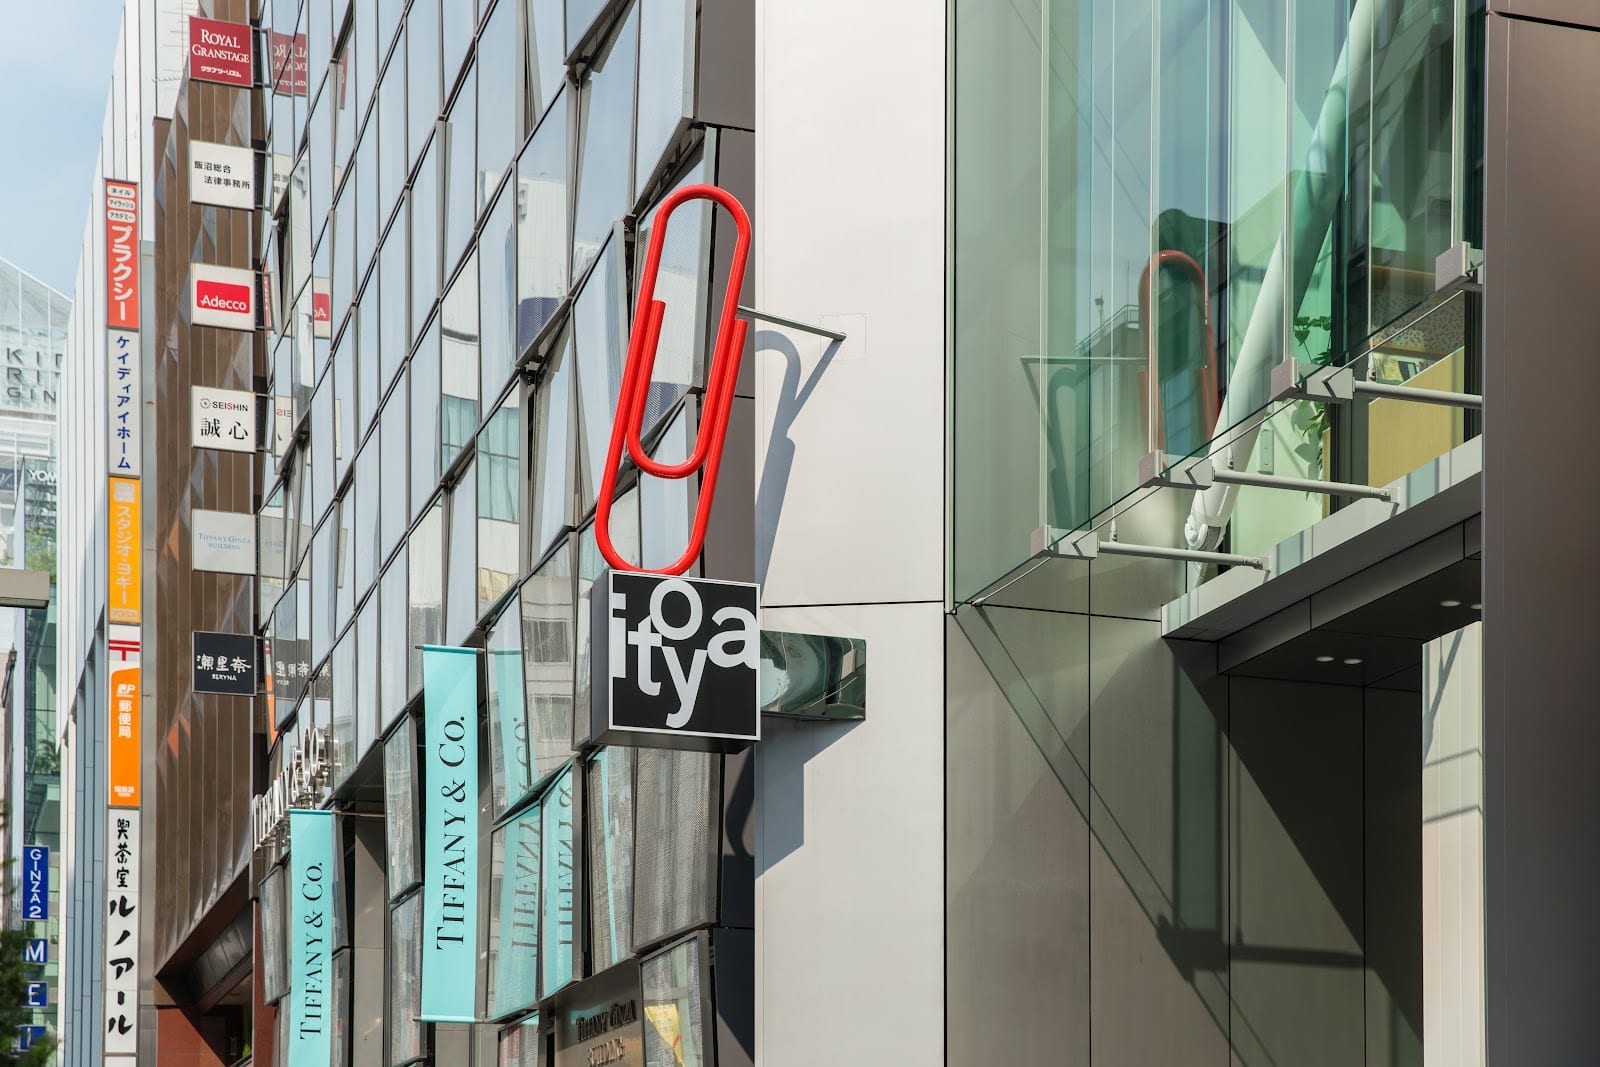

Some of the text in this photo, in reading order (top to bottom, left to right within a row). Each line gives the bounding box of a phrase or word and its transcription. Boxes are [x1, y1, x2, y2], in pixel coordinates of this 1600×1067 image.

[201, 28, 241, 49] ROYAL
[191, 44, 250, 64] GRANSTAGE
[194, 160, 232, 174] 飯沼総合
[204, 175, 250, 190] 法律事務所
[111, 225, 134, 321] プラクシー
[200, 294, 247, 311] Adecco
[6, 366, 61, 385] RI
[116, 335, 131, 469] ケイディアイホーム
[212, 401, 249, 412] SEISHIN
[200, 418, 249, 441] 誠心
[610, 578, 757, 729] itoya
[440, 778, 466, 803] &
[436, 810, 466, 950] TIFFANY
[303, 910, 323, 928] &
[299, 932, 323, 1040] TIFFANY
